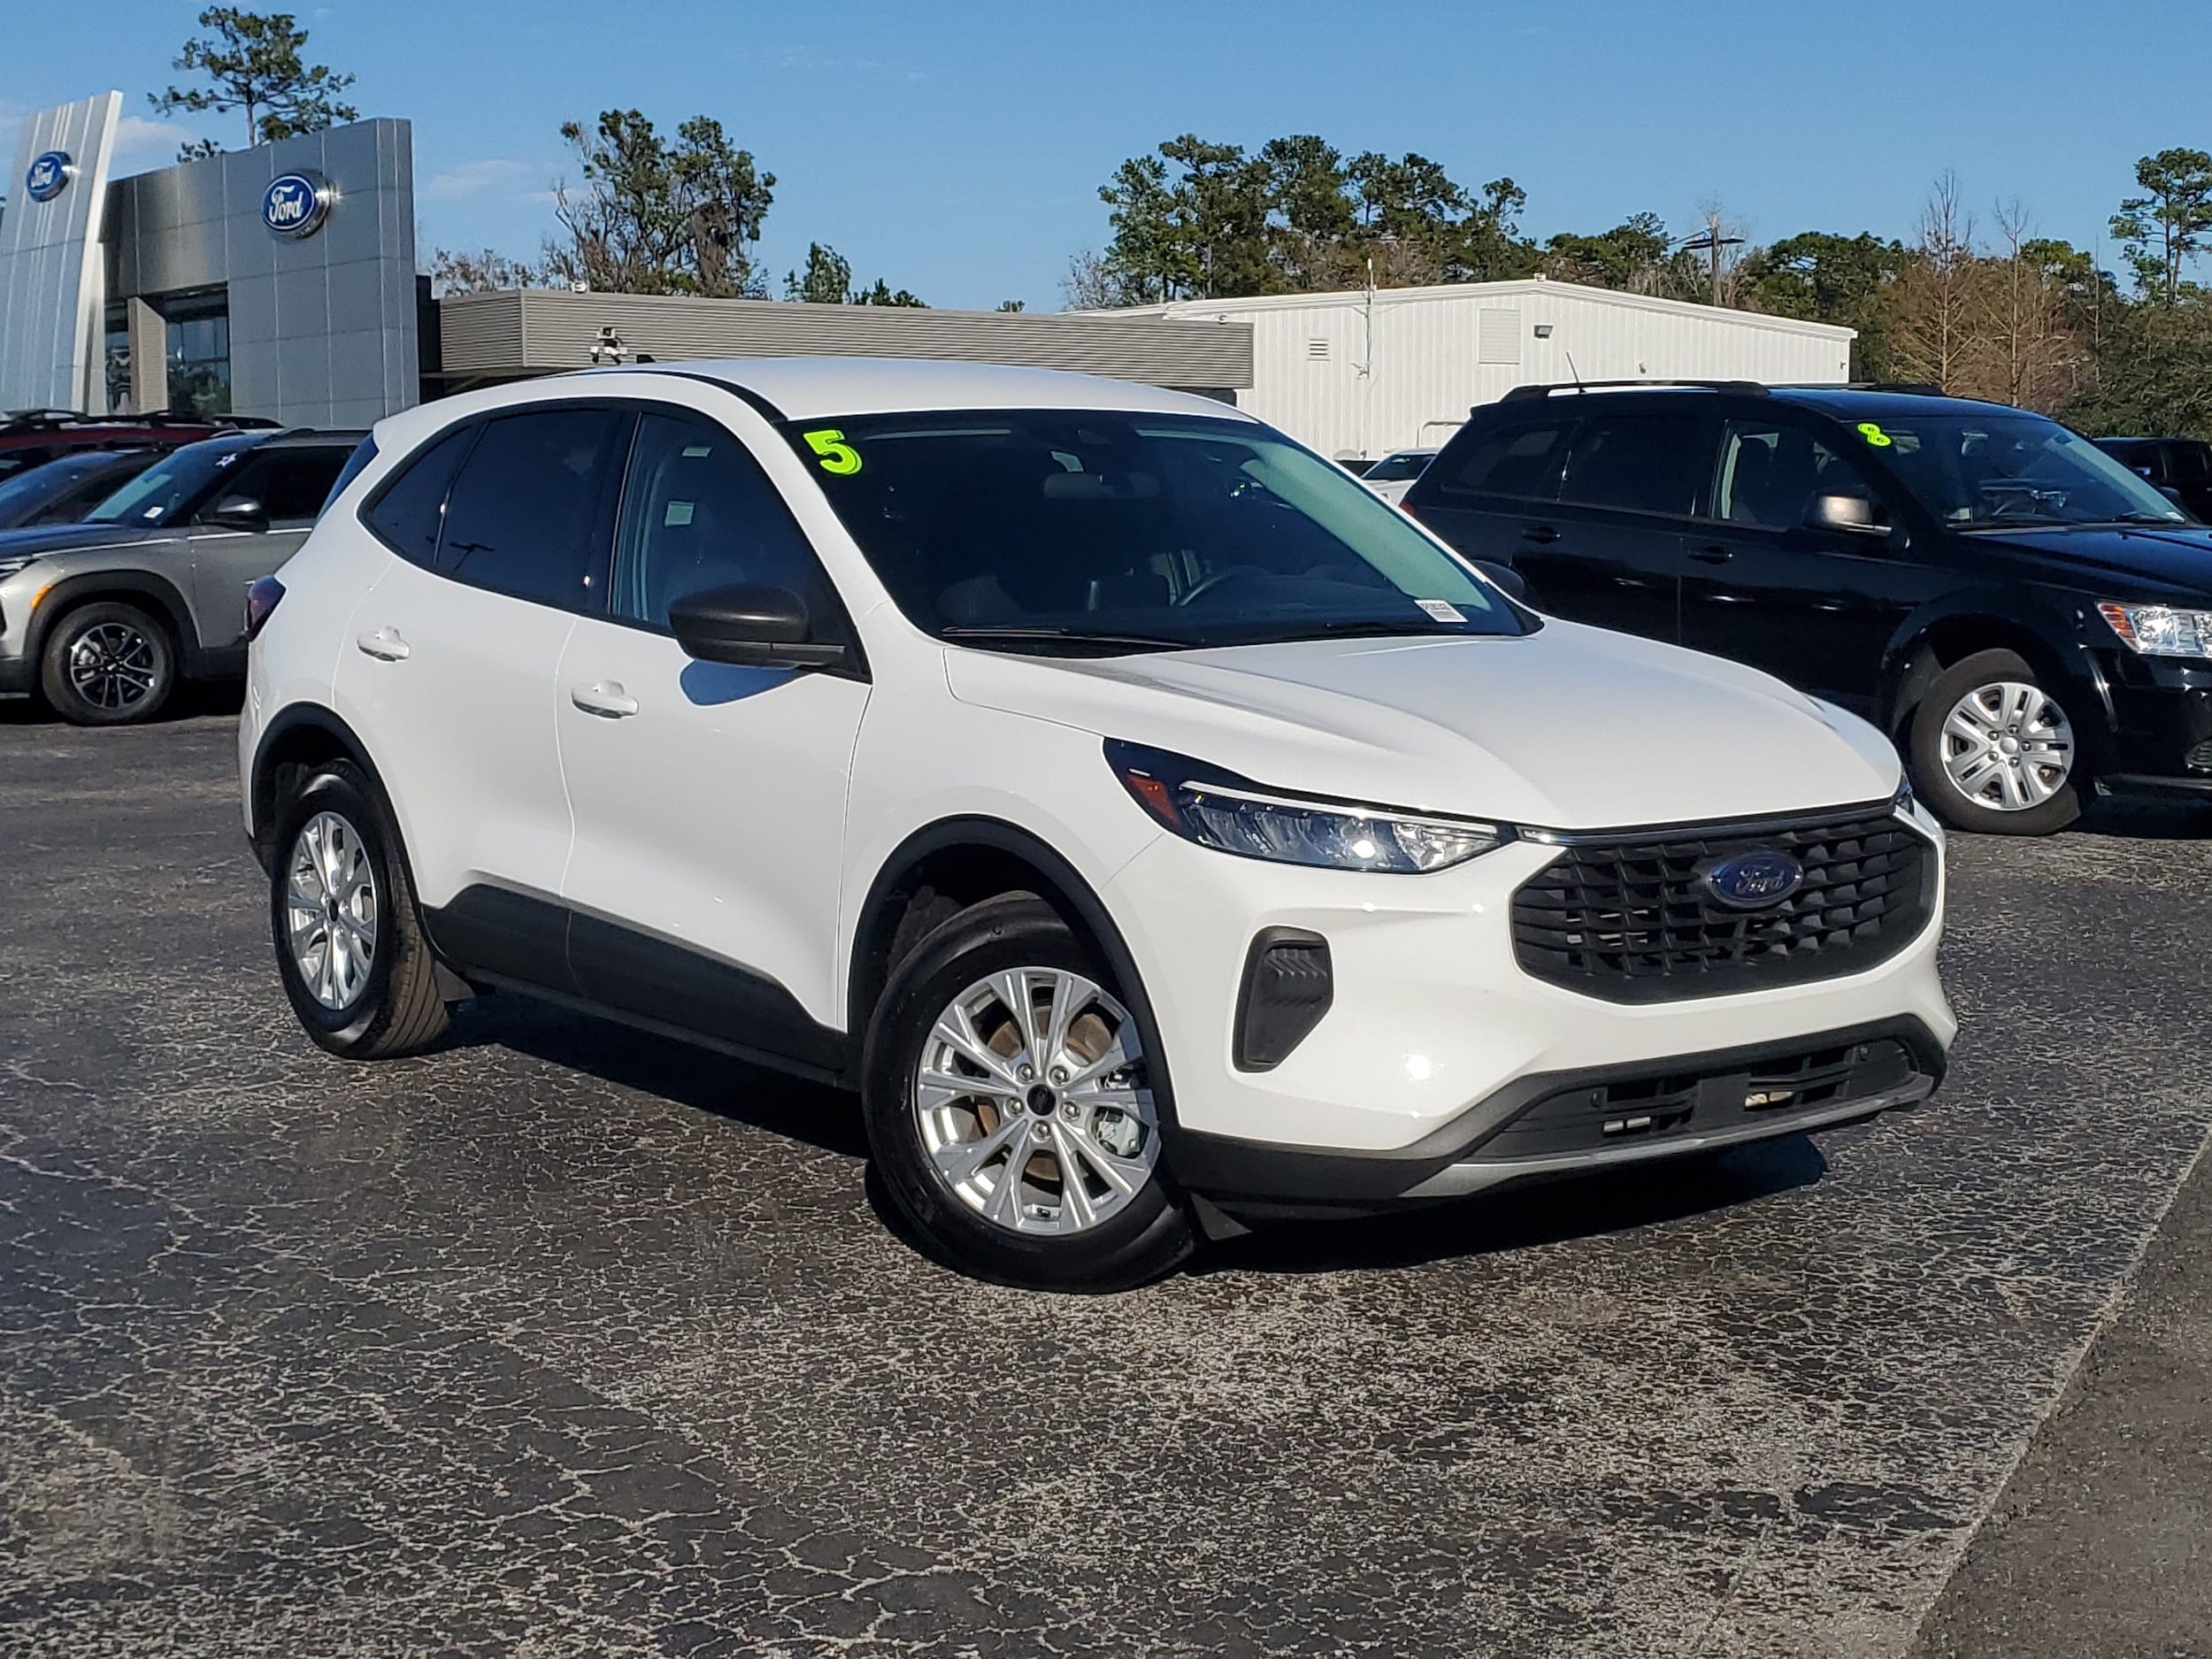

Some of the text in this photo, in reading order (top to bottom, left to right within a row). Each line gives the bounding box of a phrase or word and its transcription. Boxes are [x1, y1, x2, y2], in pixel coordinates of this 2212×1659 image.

[268, 185, 303, 223] Ford
[1857, 423, 1891, 446] 8
[803, 430, 863, 474] 5
[1736, 864, 1784, 895] Ford
